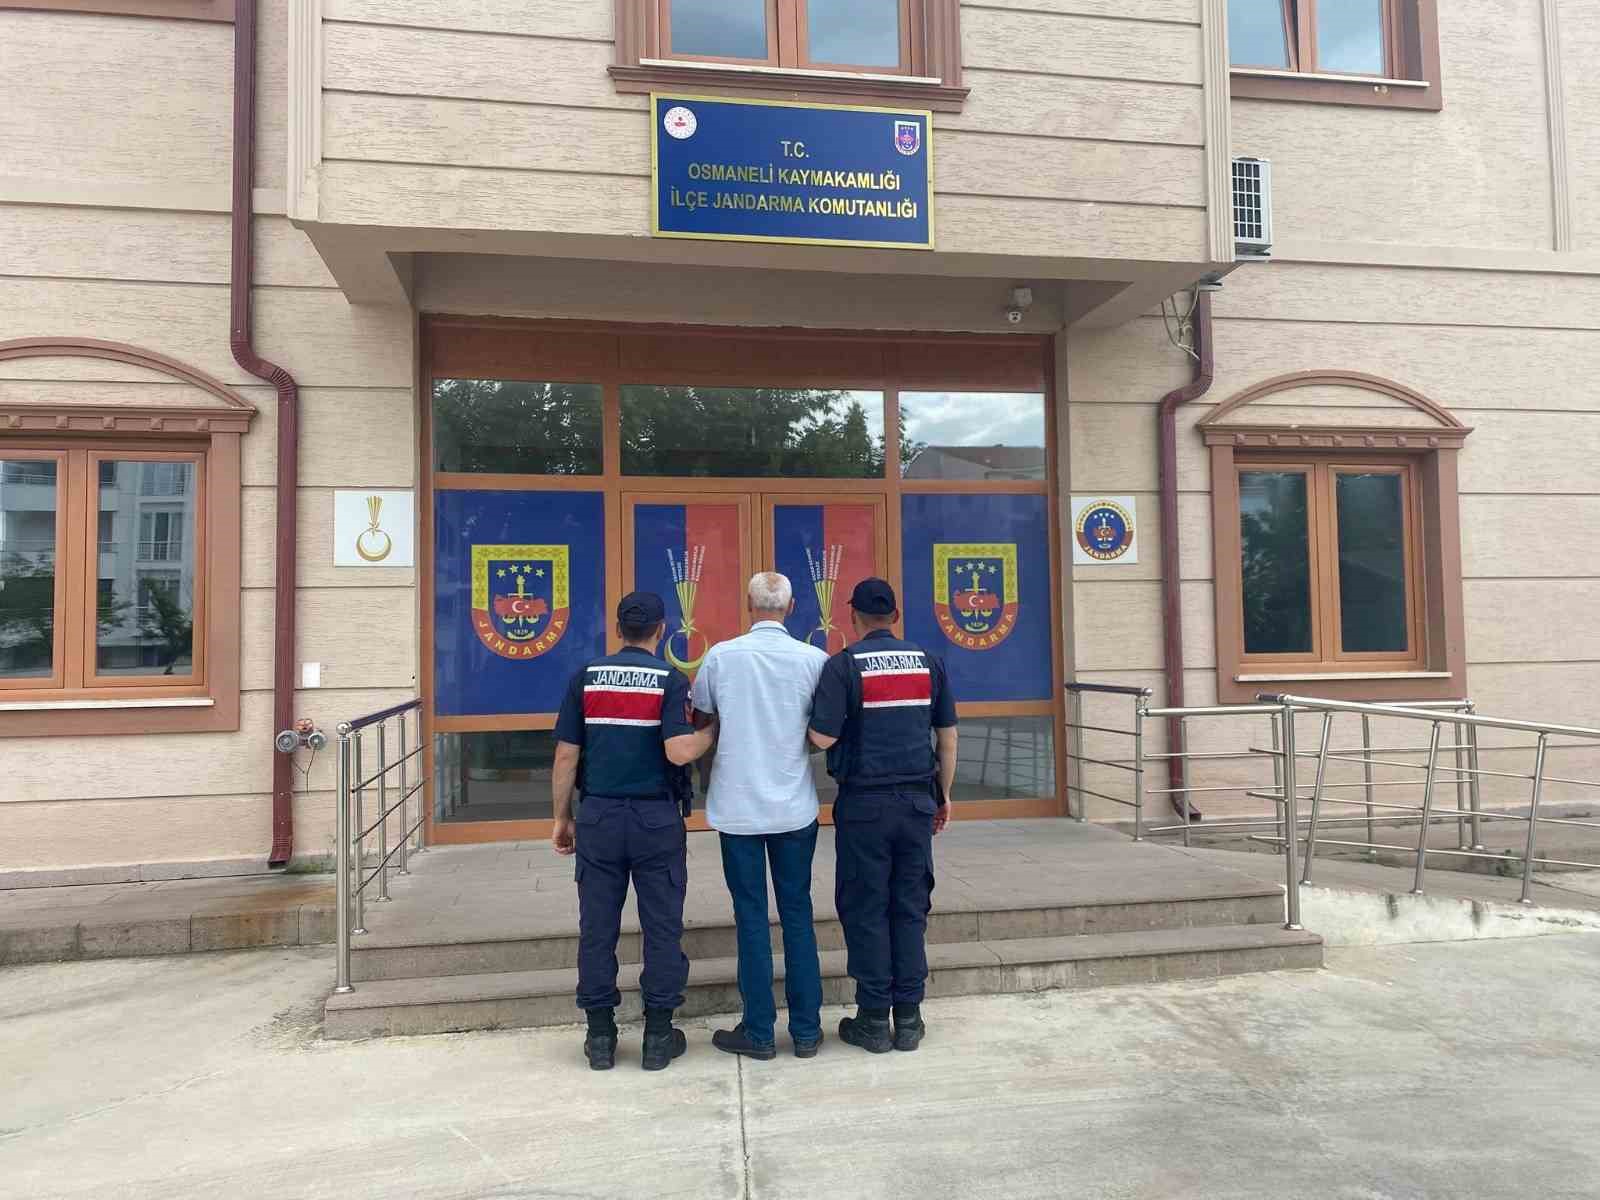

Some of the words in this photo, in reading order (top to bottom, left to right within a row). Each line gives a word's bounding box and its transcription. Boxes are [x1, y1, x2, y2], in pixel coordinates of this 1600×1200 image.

[780, 141, 810, 158] T.C.
[688, 163, 773, 183] OSMANELİ
[778, 168, 900, 190] KAYMAKAMLIĞI
[671, 186, 709, 212] İLÇE
[713, 192, 805, 213] JANDARMA
[808, 197, 917, 218] KOMUTANLIĞI
[479, 620, 564, 656] JANDARMA
[940, 613, 1014, 646] JANDARMA
[865, 655, 924, 672] JANDARMA
[592, 670, 659, 688] JANDARMA
